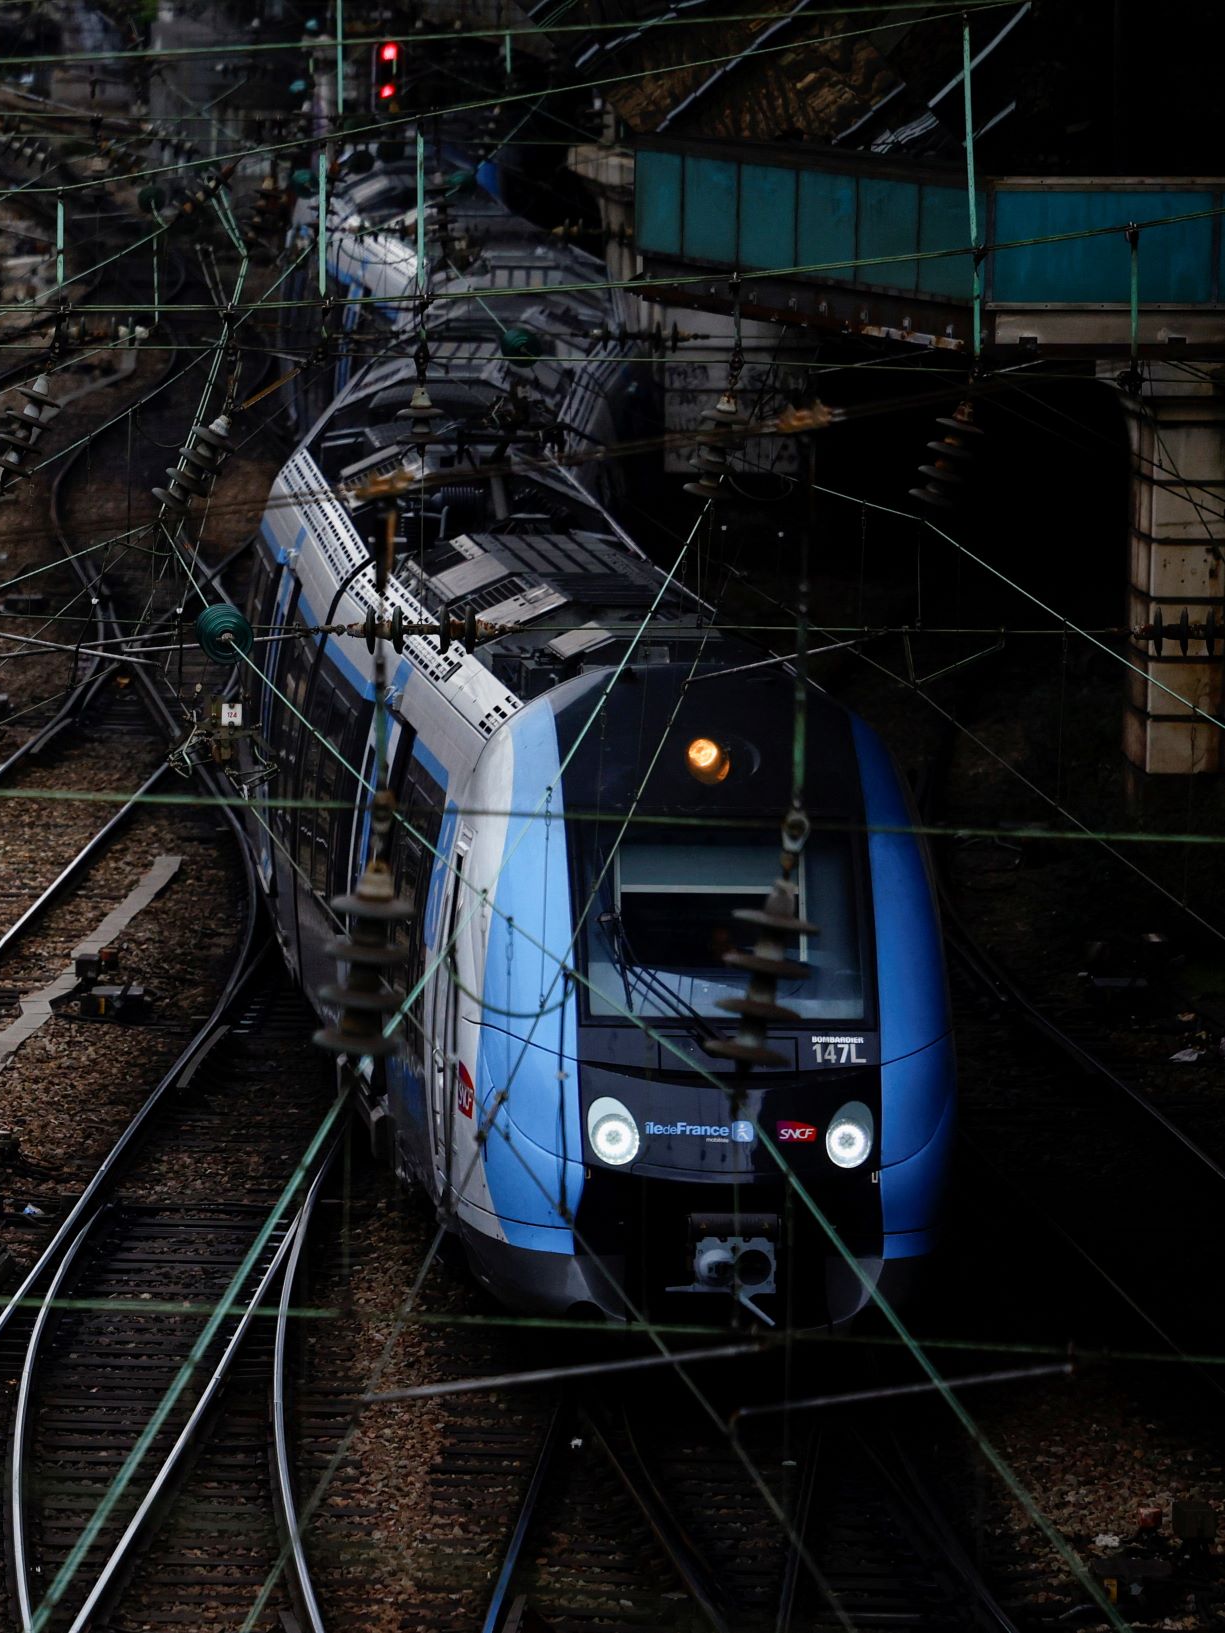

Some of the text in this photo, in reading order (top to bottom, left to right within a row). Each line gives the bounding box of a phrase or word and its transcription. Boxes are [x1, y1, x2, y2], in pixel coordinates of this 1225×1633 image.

[811, 1035, 865, 1044] BOMBARDIER
[812, 1043, 867, 1064] 147L
[778, 1128, 815, 1140] SNCF
